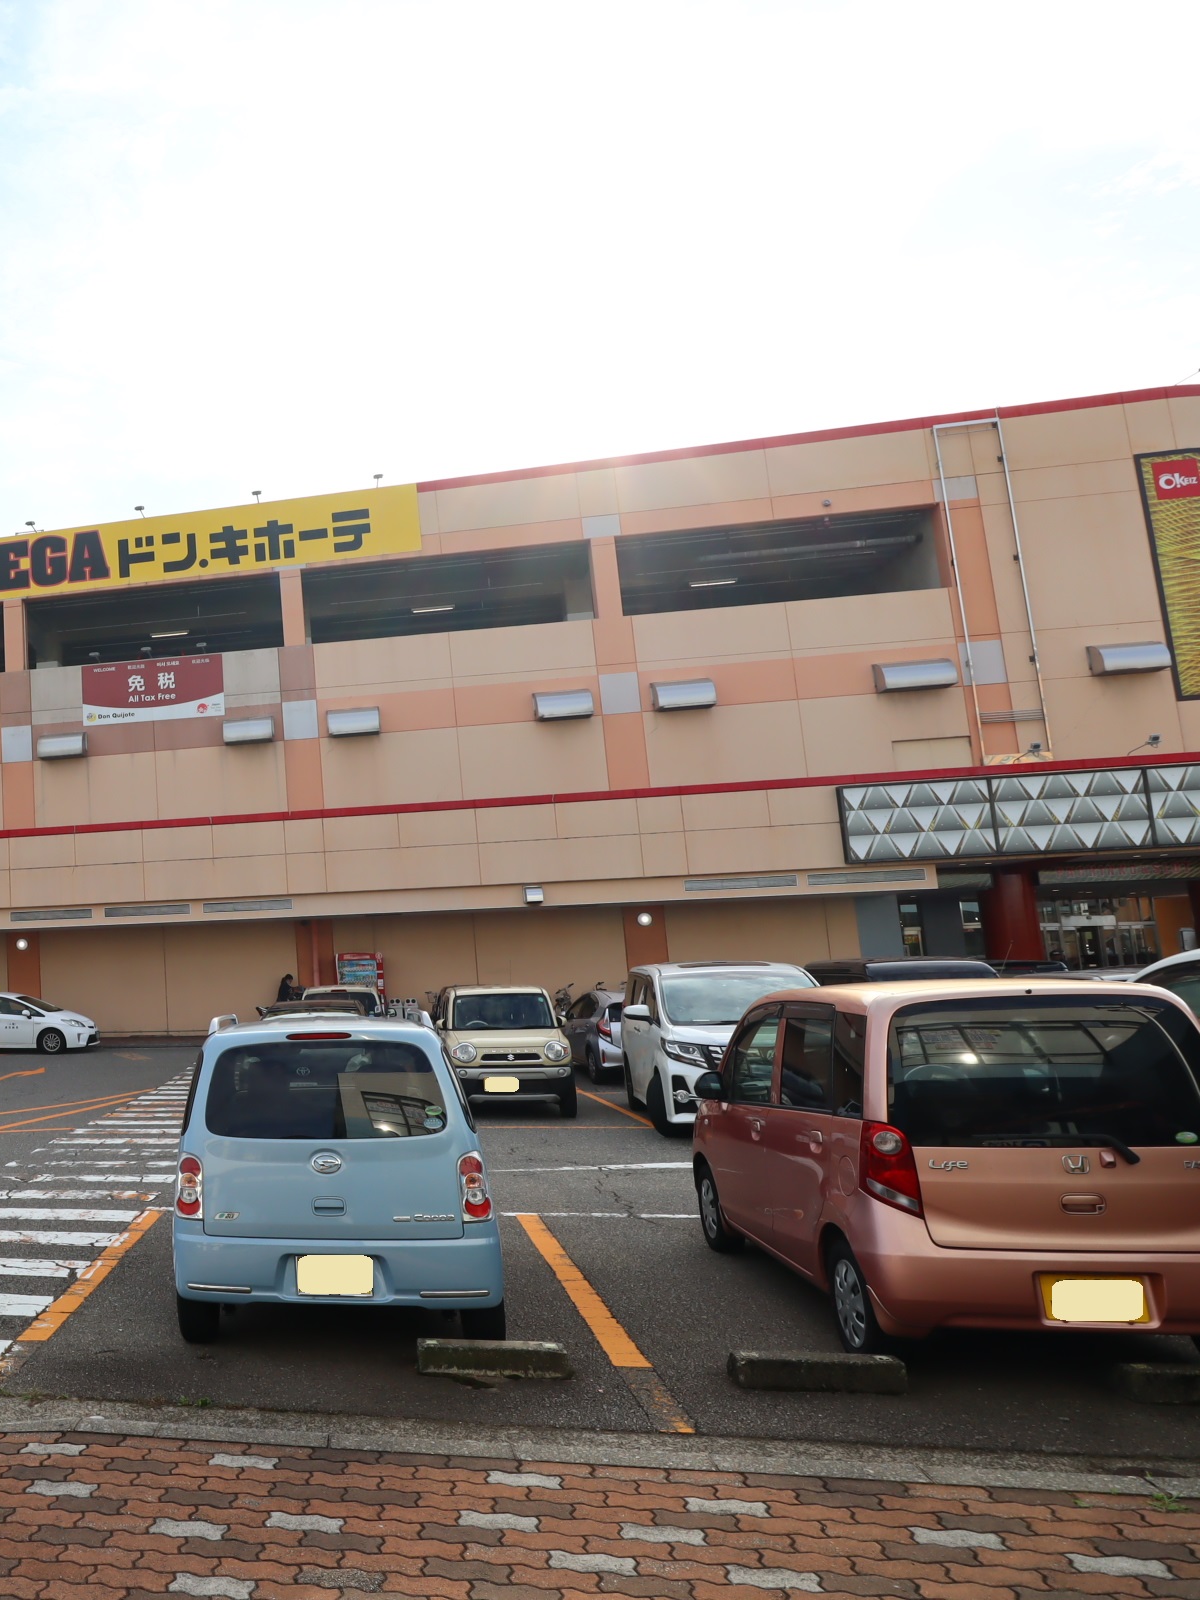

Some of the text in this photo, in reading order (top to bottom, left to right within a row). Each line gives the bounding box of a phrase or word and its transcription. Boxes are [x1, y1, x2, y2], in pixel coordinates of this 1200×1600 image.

[128, 692, 177, 703] All Tax Free
[112, 711, 136, 719] Quijote
[928, 1158, 969, 1170] Life
